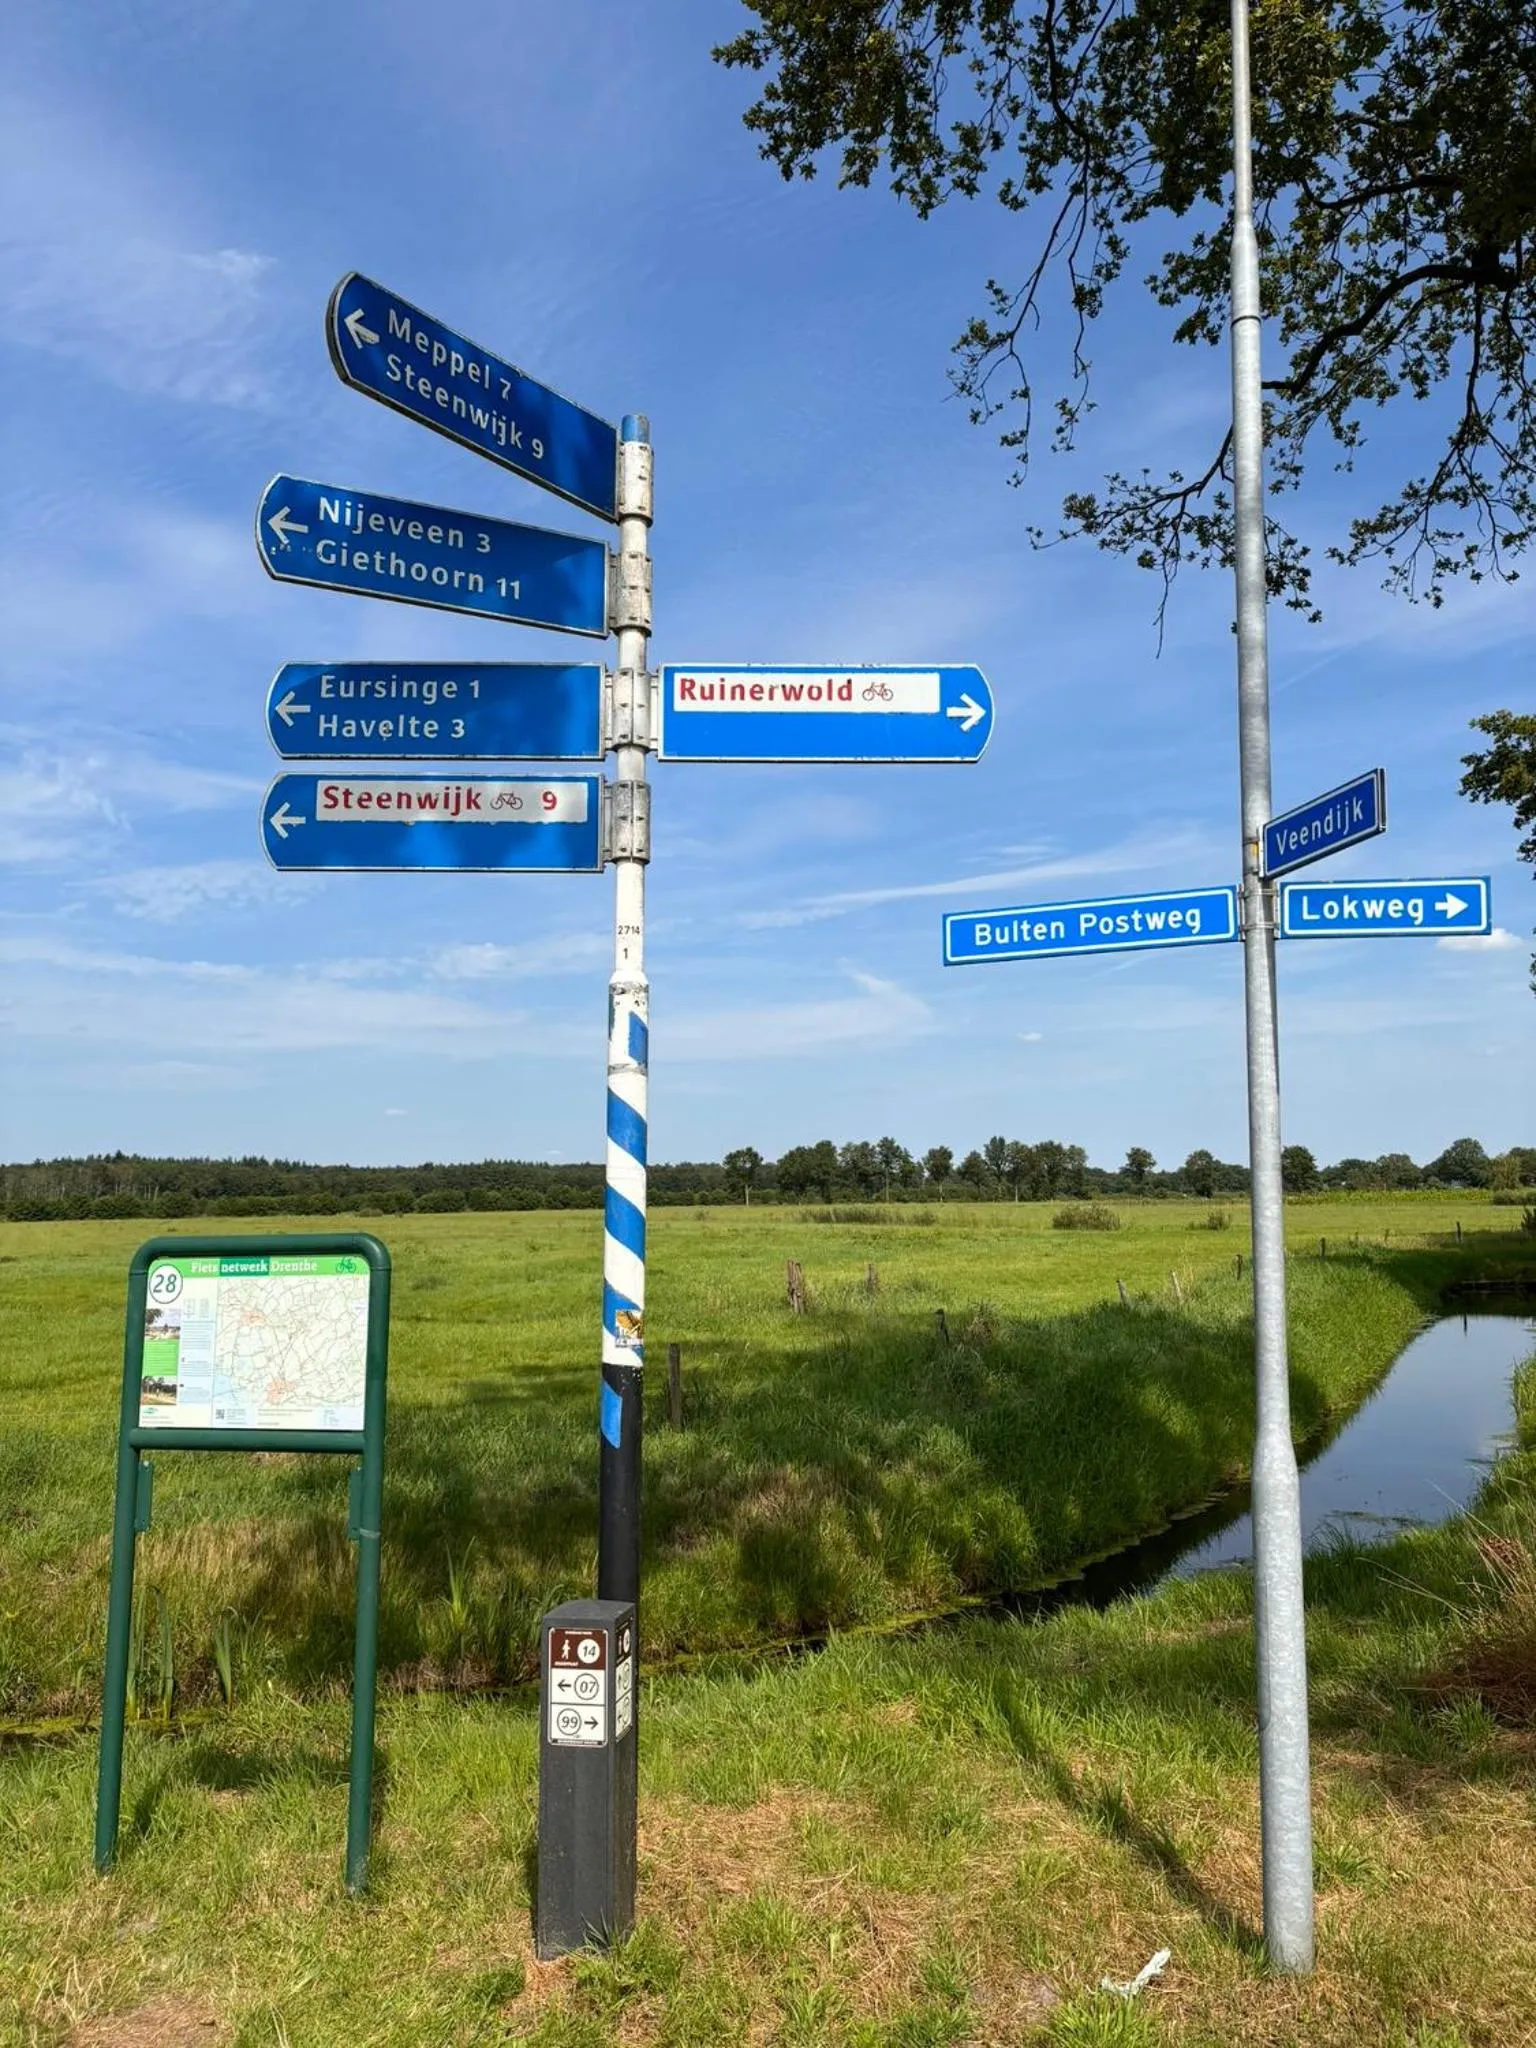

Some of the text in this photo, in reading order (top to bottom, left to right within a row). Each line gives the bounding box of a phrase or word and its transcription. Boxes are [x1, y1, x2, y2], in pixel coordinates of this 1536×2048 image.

[388, 308, 512, 400] Meppel 7
[386, 354, 544, 460] Steenwijk 9
[318, 496, 491, 553] Nijeveen 3
[316, 539, 521, 600] Giethoorn 11
[320, 675, 480, 705] Eursinge 1
[679, 677, 853, 702] Ruinerwold
[318, 714, 465, 738] Havelte 3
[323, 785, 557, 816] Steenwijk 9
[1275, 796, 1364, 856] Veendijk
[1302, 894, 1424, 925] Lokweg
[618, 924, 640, 935] 2714
[974, 908, 1201, 946] Bulten Postweg
[152, 1273, 178, 1294] 28
[582, 1645, 596, 1657] 14
[579, 1681, 596, 1694] 07
[561, 1716, 578, 1729] 99
